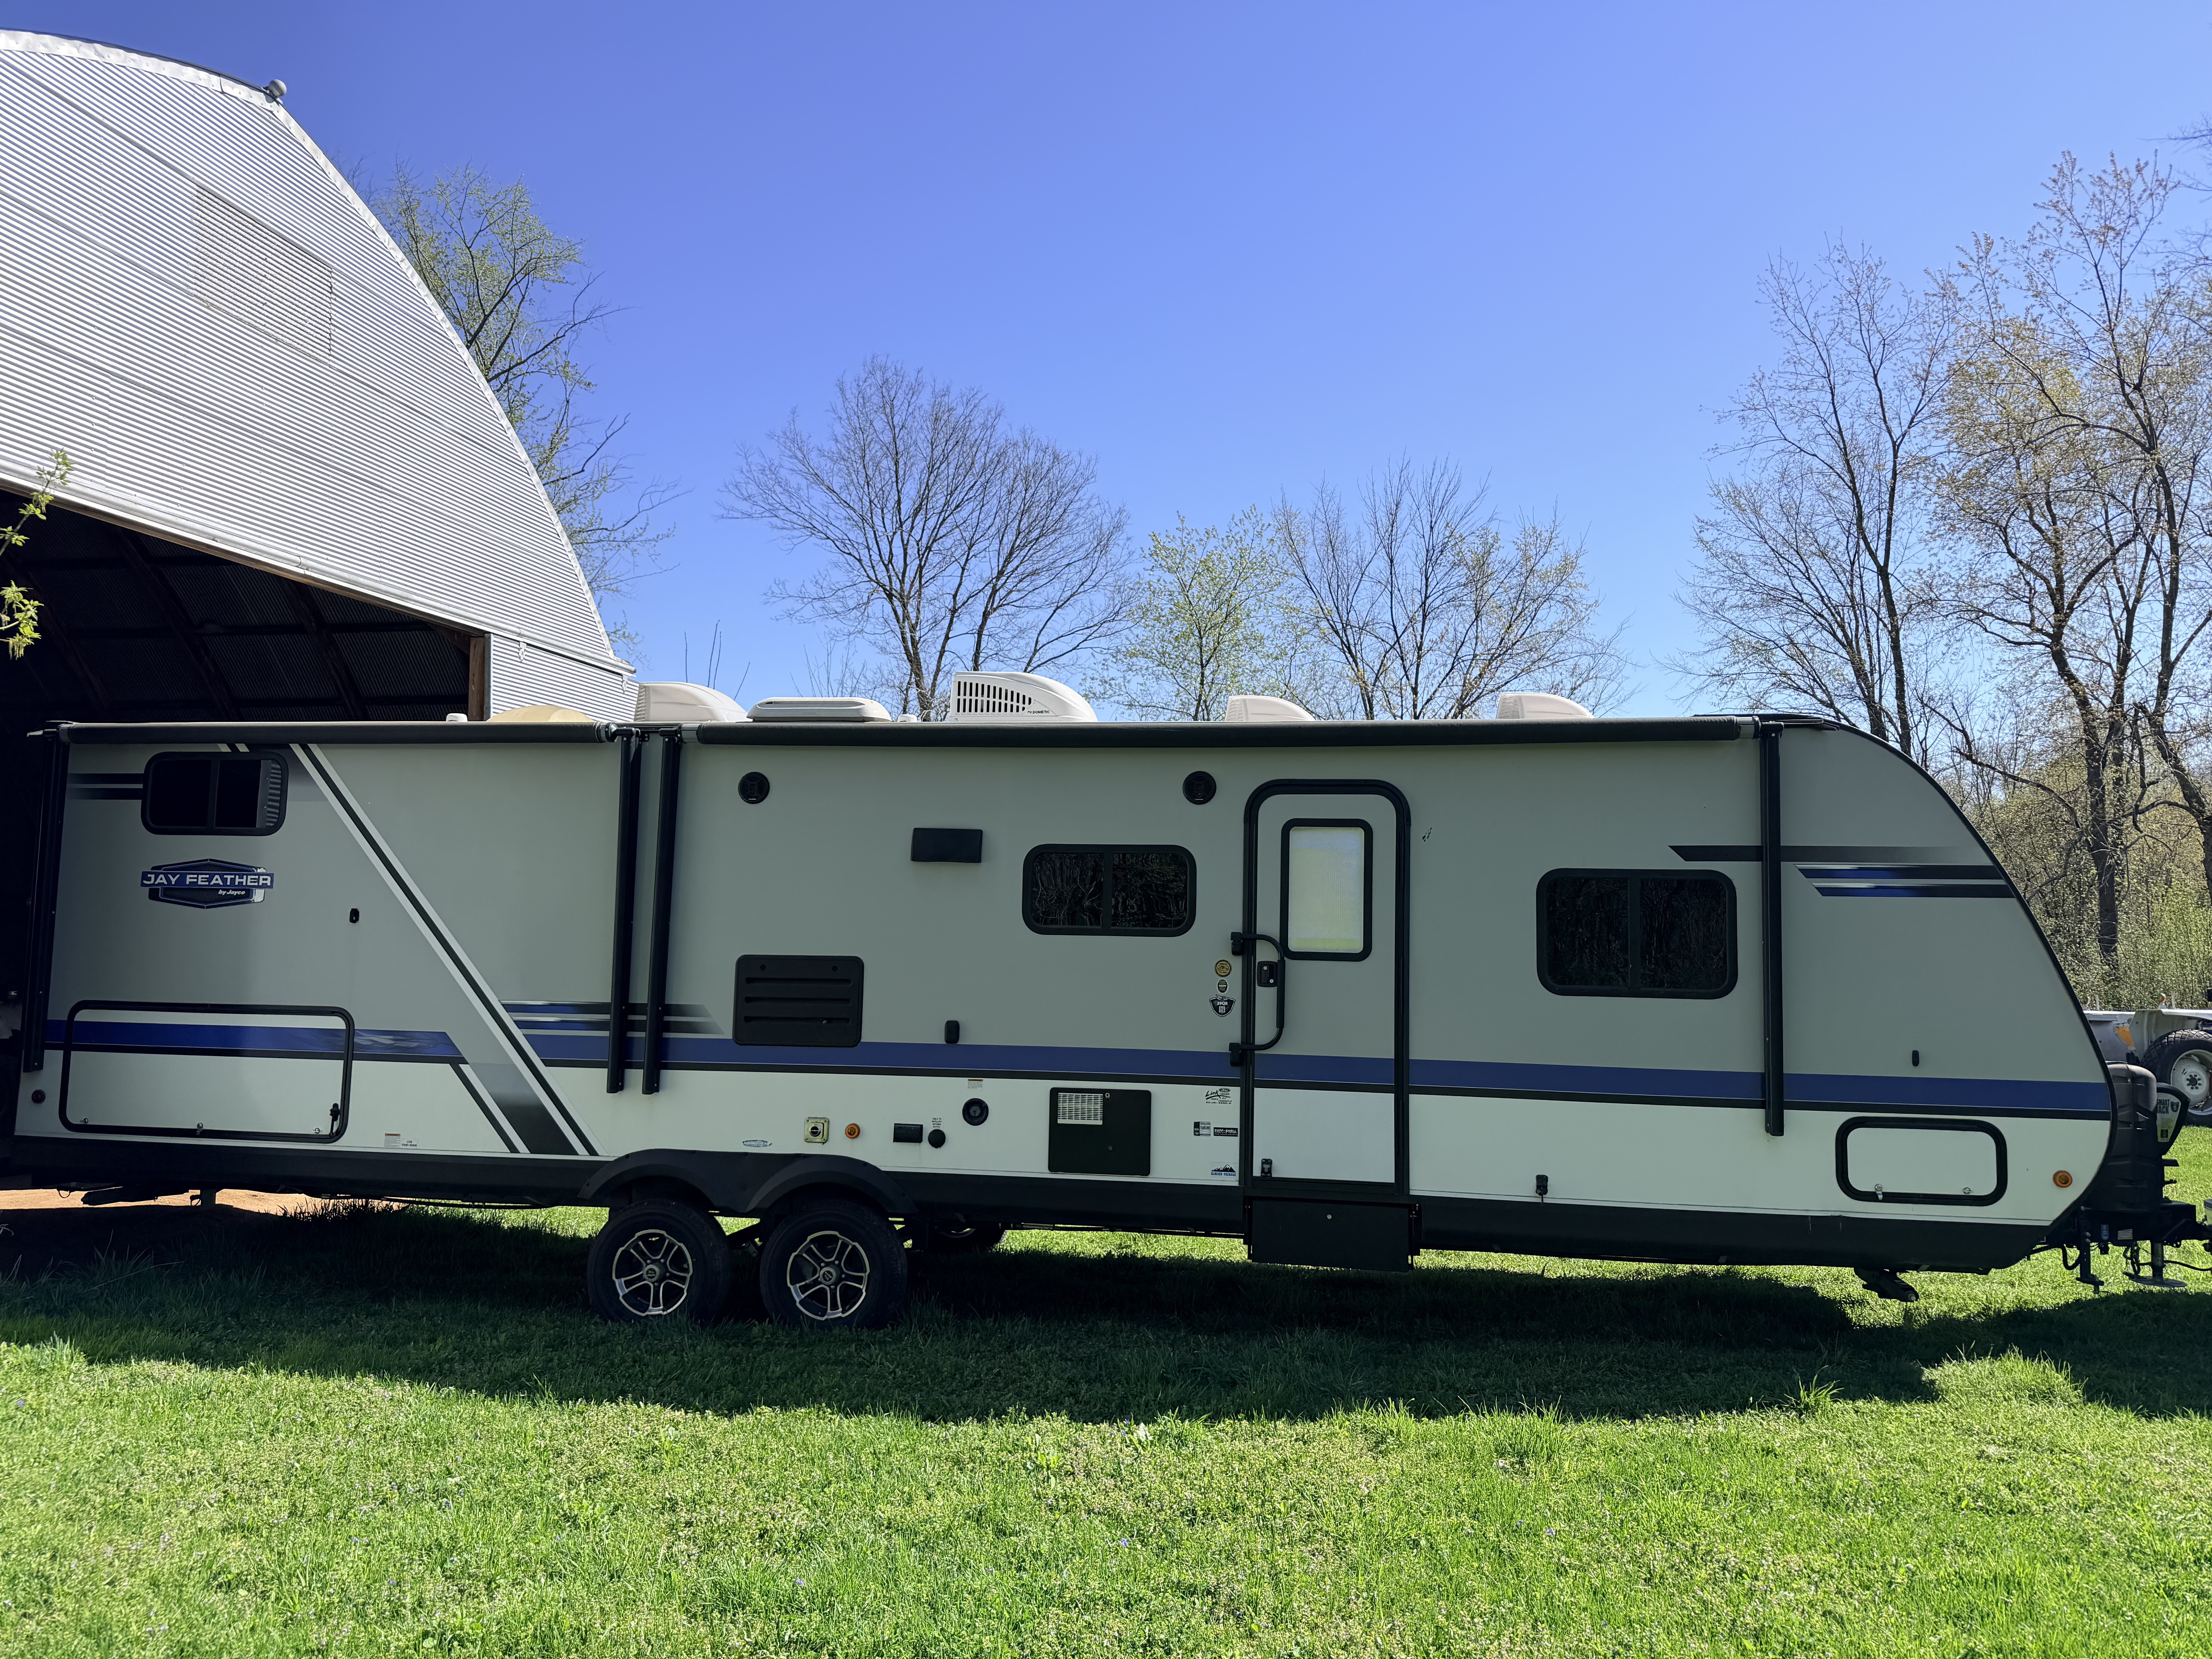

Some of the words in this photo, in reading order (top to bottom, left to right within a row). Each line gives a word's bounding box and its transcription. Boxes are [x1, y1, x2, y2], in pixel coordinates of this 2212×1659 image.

[143, 874, 180, 884] JAY
[186, 874, 271, 886] FEATHER
[2157, 1105, 2169, 1114] ACK
